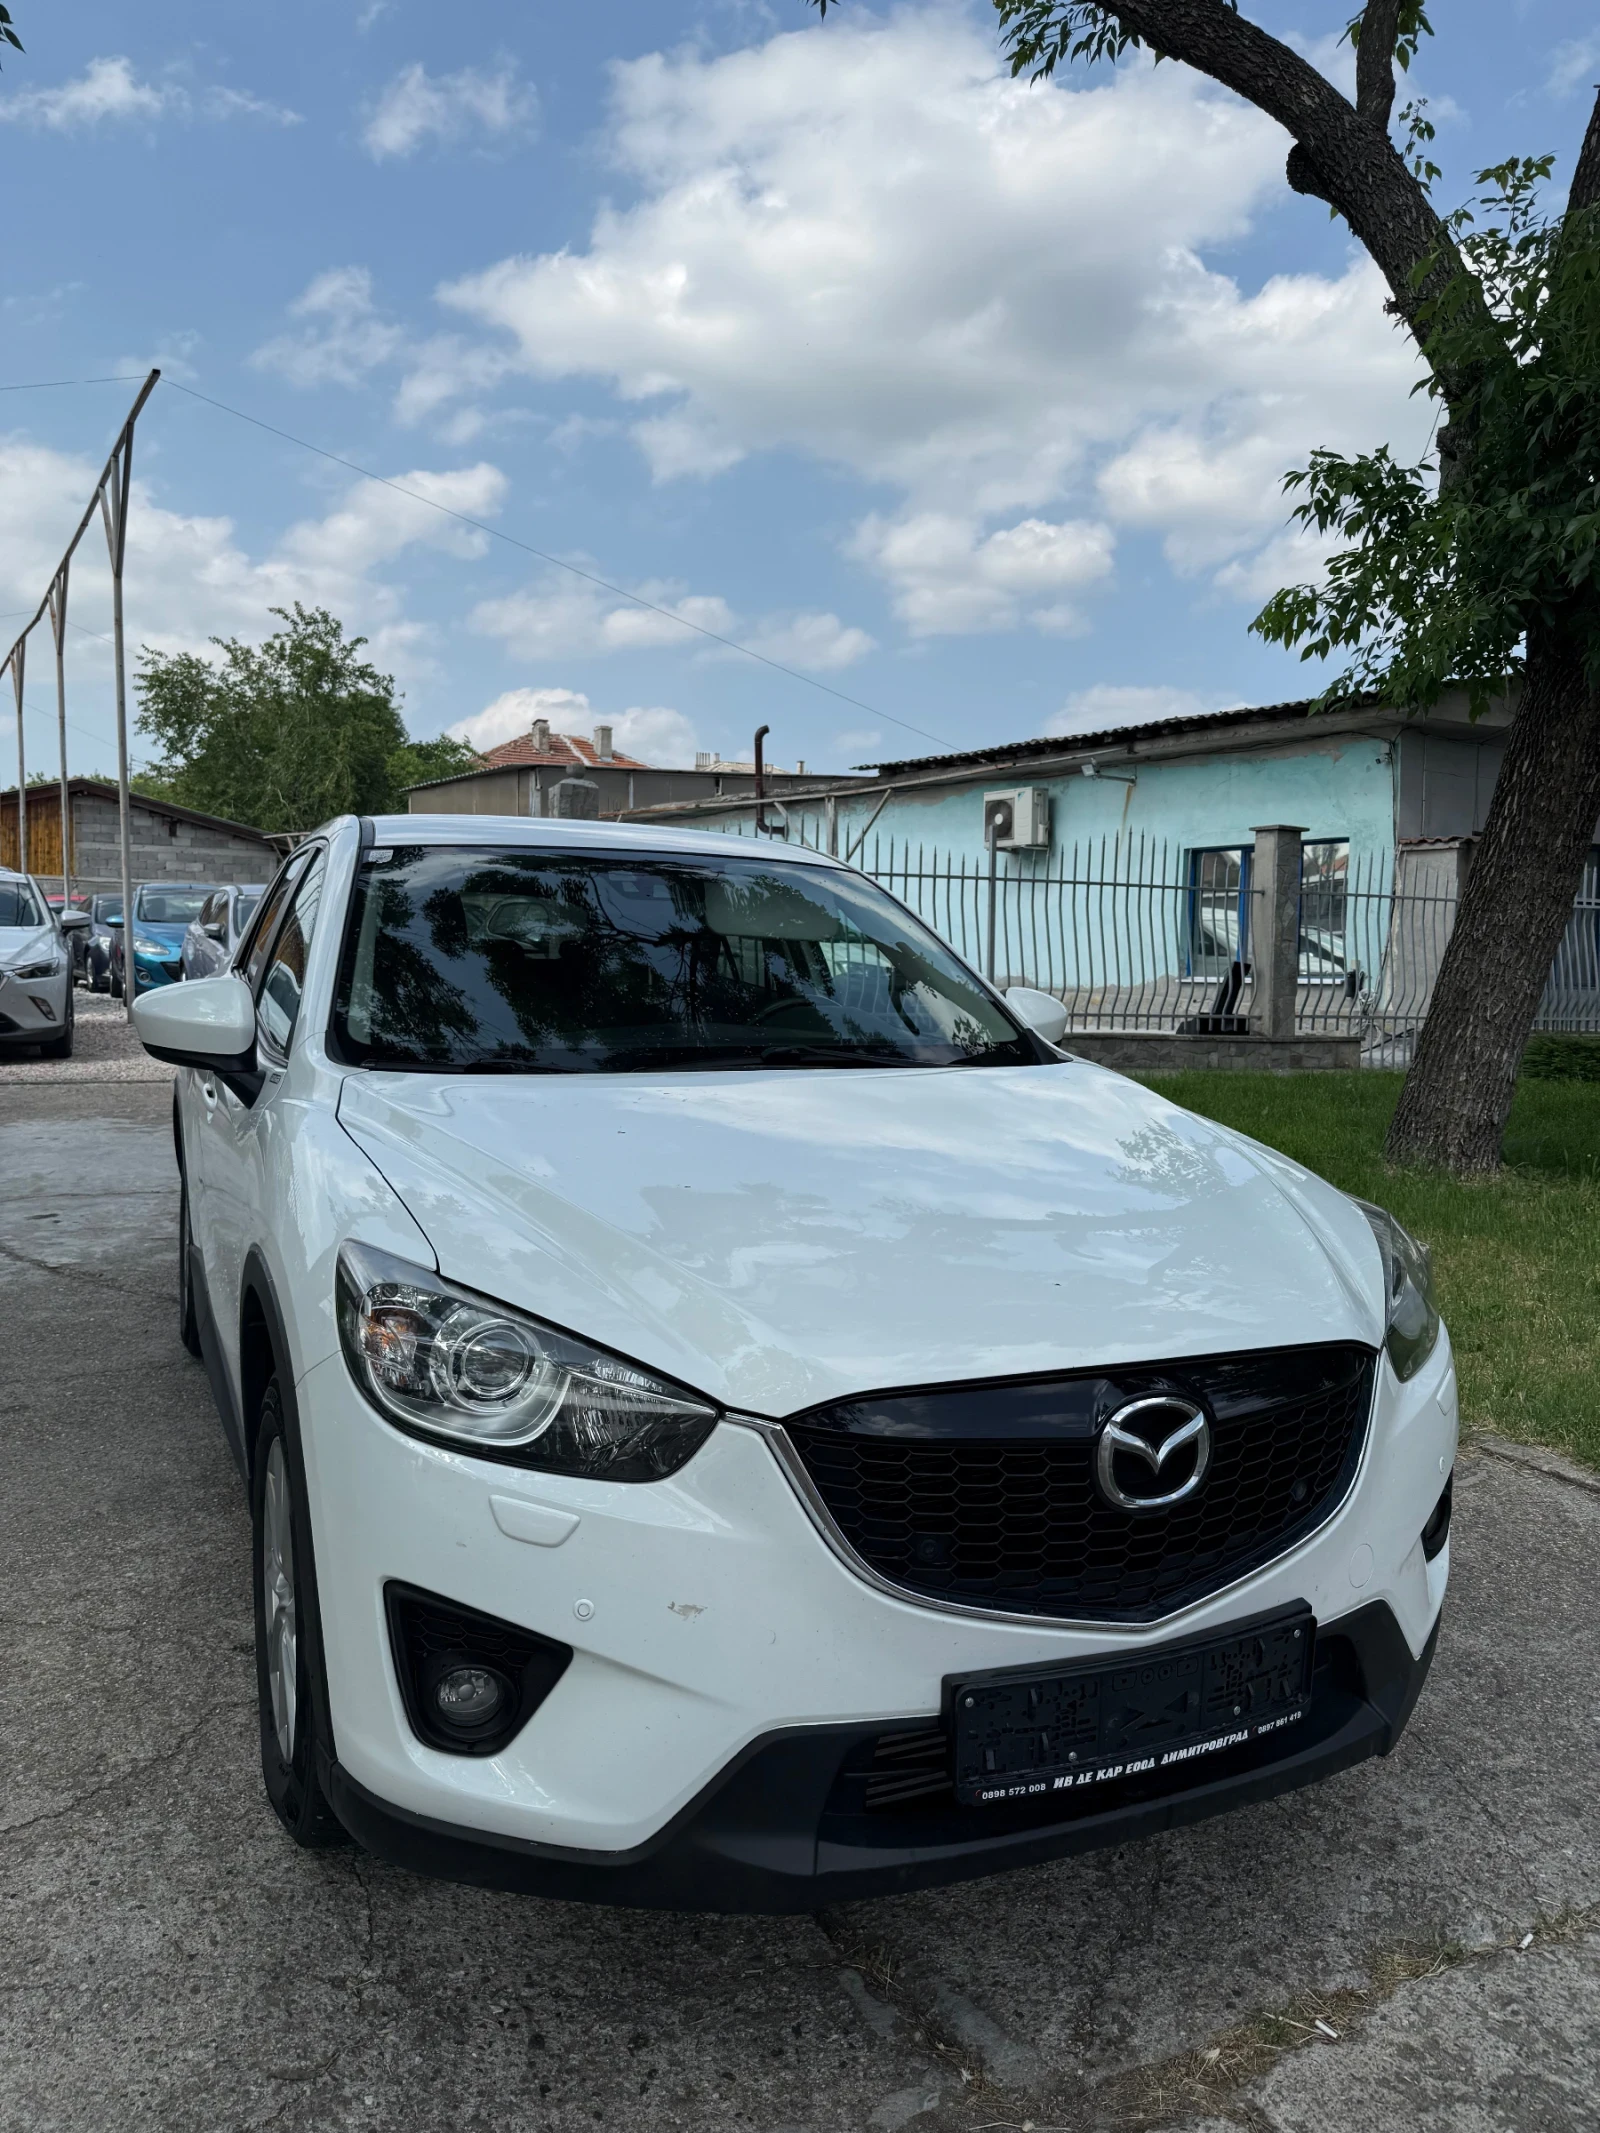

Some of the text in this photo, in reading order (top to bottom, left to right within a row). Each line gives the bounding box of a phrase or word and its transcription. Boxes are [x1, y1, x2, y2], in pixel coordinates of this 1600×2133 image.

[982, 1790, 1006, 1800] 0898
[1008, 1787, 1026, 1796] 572
[1028, 1784, 1046, 1793] 008
[1053, 1775, 1074, 1789] ИВ
[1076, 1772, 1094, 1785] ДЕ
[1096, 1765, 1123, 1781] КАР
[1125, 1757, 1156, 1774] ЕООД
[1160, 1729, 1249, 1765] ДИМИТРОВГРАД
[1257, 1721, 1275, 1734] 0897
